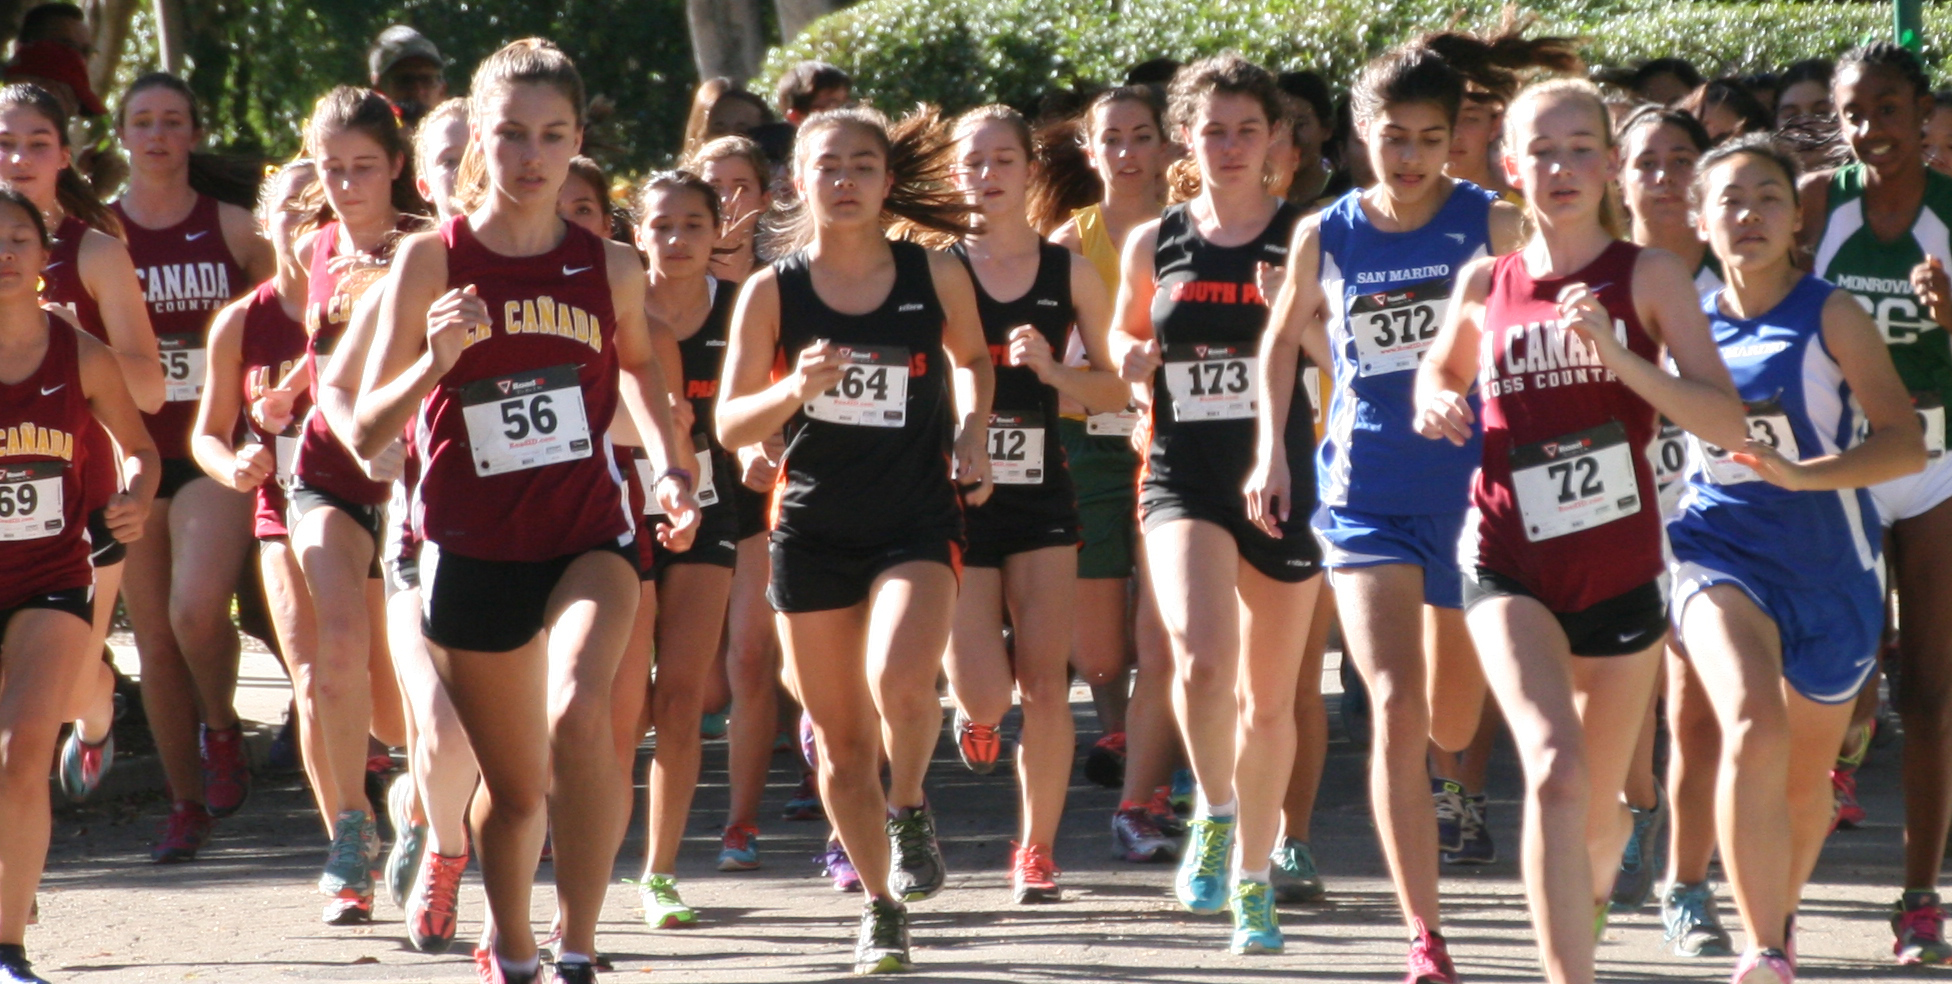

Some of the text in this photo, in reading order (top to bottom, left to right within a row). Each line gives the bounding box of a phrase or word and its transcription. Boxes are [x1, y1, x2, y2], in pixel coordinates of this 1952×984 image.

[1357, 264, 1450, 284] SAN MARINO
[504, 295, 602, 353] CAÑADA
[1370, 304, 1439, 347] 372
[1505, 317, 1629, 375] CANAA
[1188, 360, 1249, 395] 173
[1535, 367, 1618, 390] COUNTR
[500, 394, 557, 441] 56
[986, 429, 1026, 462] 12
[1548, 456, 1605, 504] 72
[0, 483, 38, 518] 69
